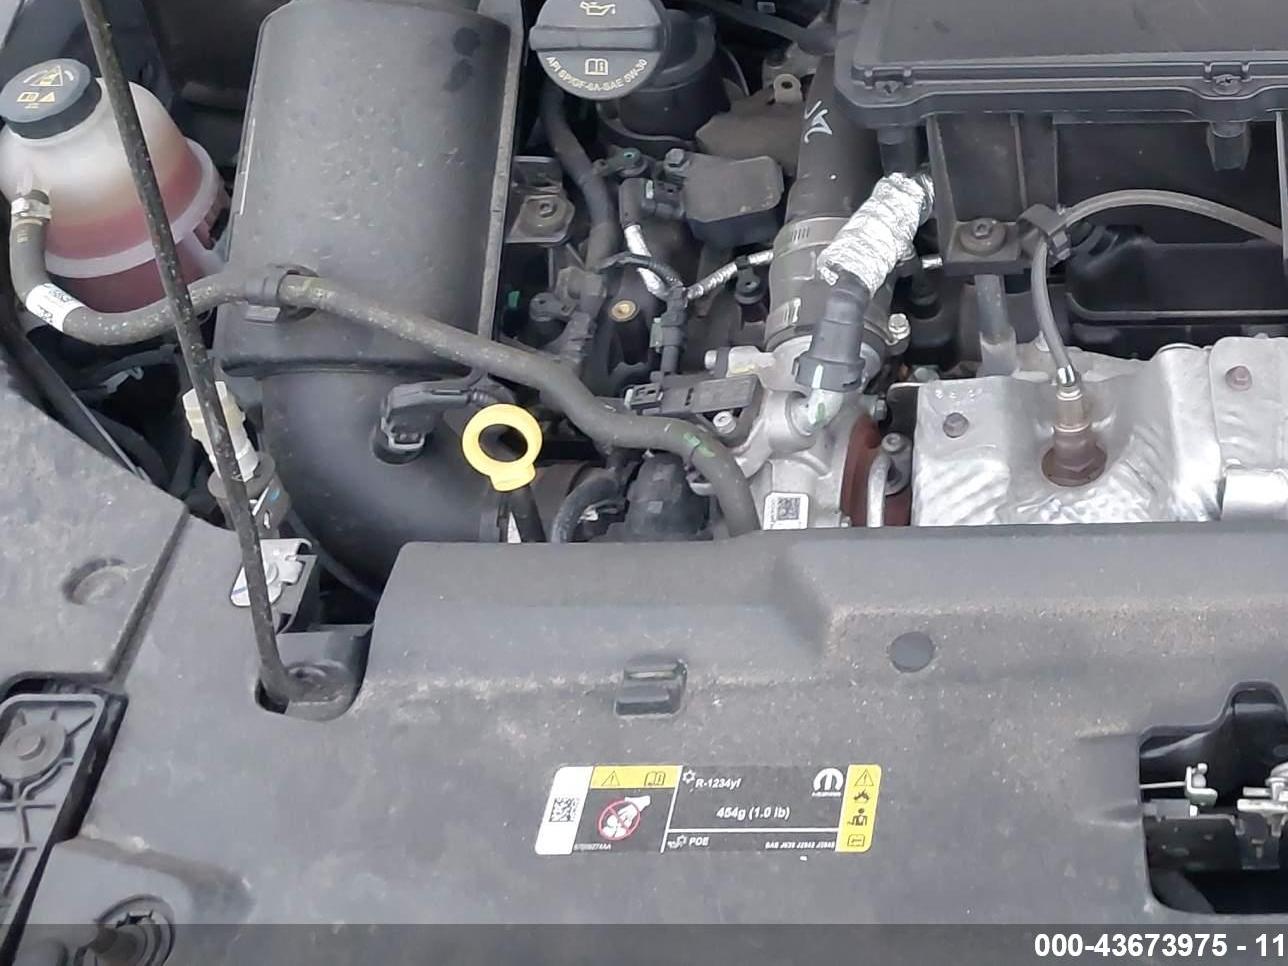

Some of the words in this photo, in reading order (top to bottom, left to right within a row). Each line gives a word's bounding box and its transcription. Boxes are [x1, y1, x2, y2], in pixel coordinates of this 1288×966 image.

[546, 56, 561, 72] API
[623, 58, 648, 83] 5W-30
[695, 777, 742, 790] R-1234yf
[716, 807, 746, 821] 454g
[748, 807, 771, 820] (1.0
[774, 806, 790, 820] lb)
[688, 837, 709, 846] POE
